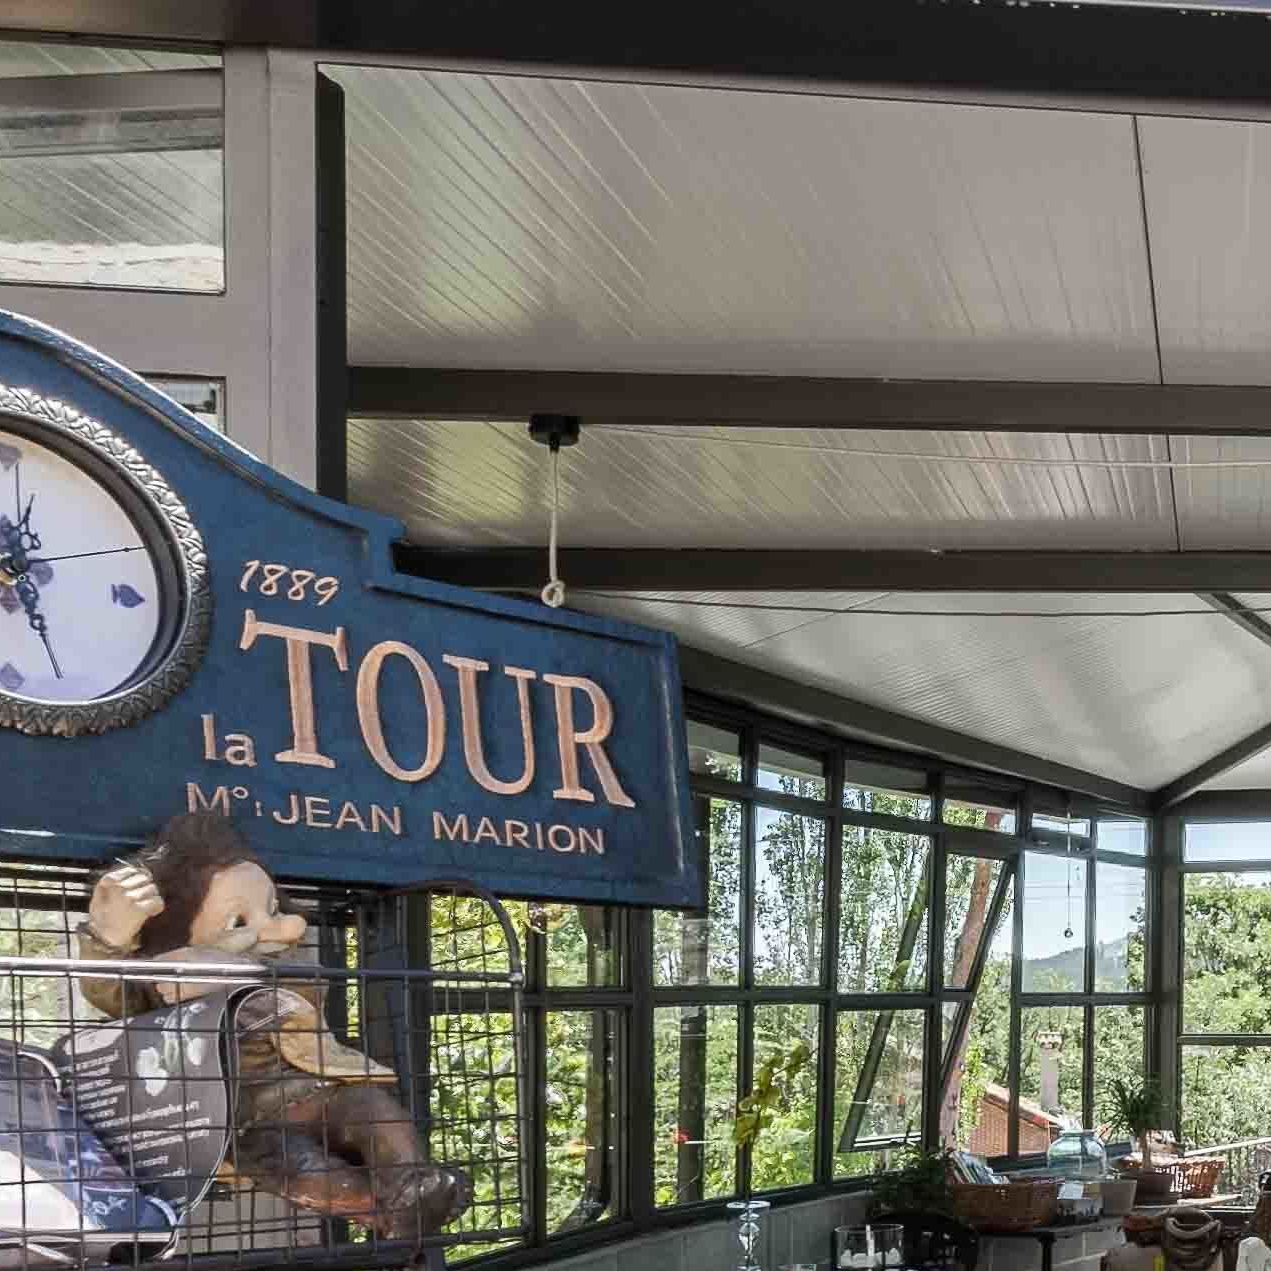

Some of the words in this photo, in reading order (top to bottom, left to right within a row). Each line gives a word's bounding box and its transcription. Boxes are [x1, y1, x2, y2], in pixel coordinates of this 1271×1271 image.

[239, 559, 339, 606] 1889
[201, 714, 256, 767] la
[238, 608, 635, 808] TOUR
[273, 793, 401, 835] JEAN
[432, 811, 605, 855] MARION
